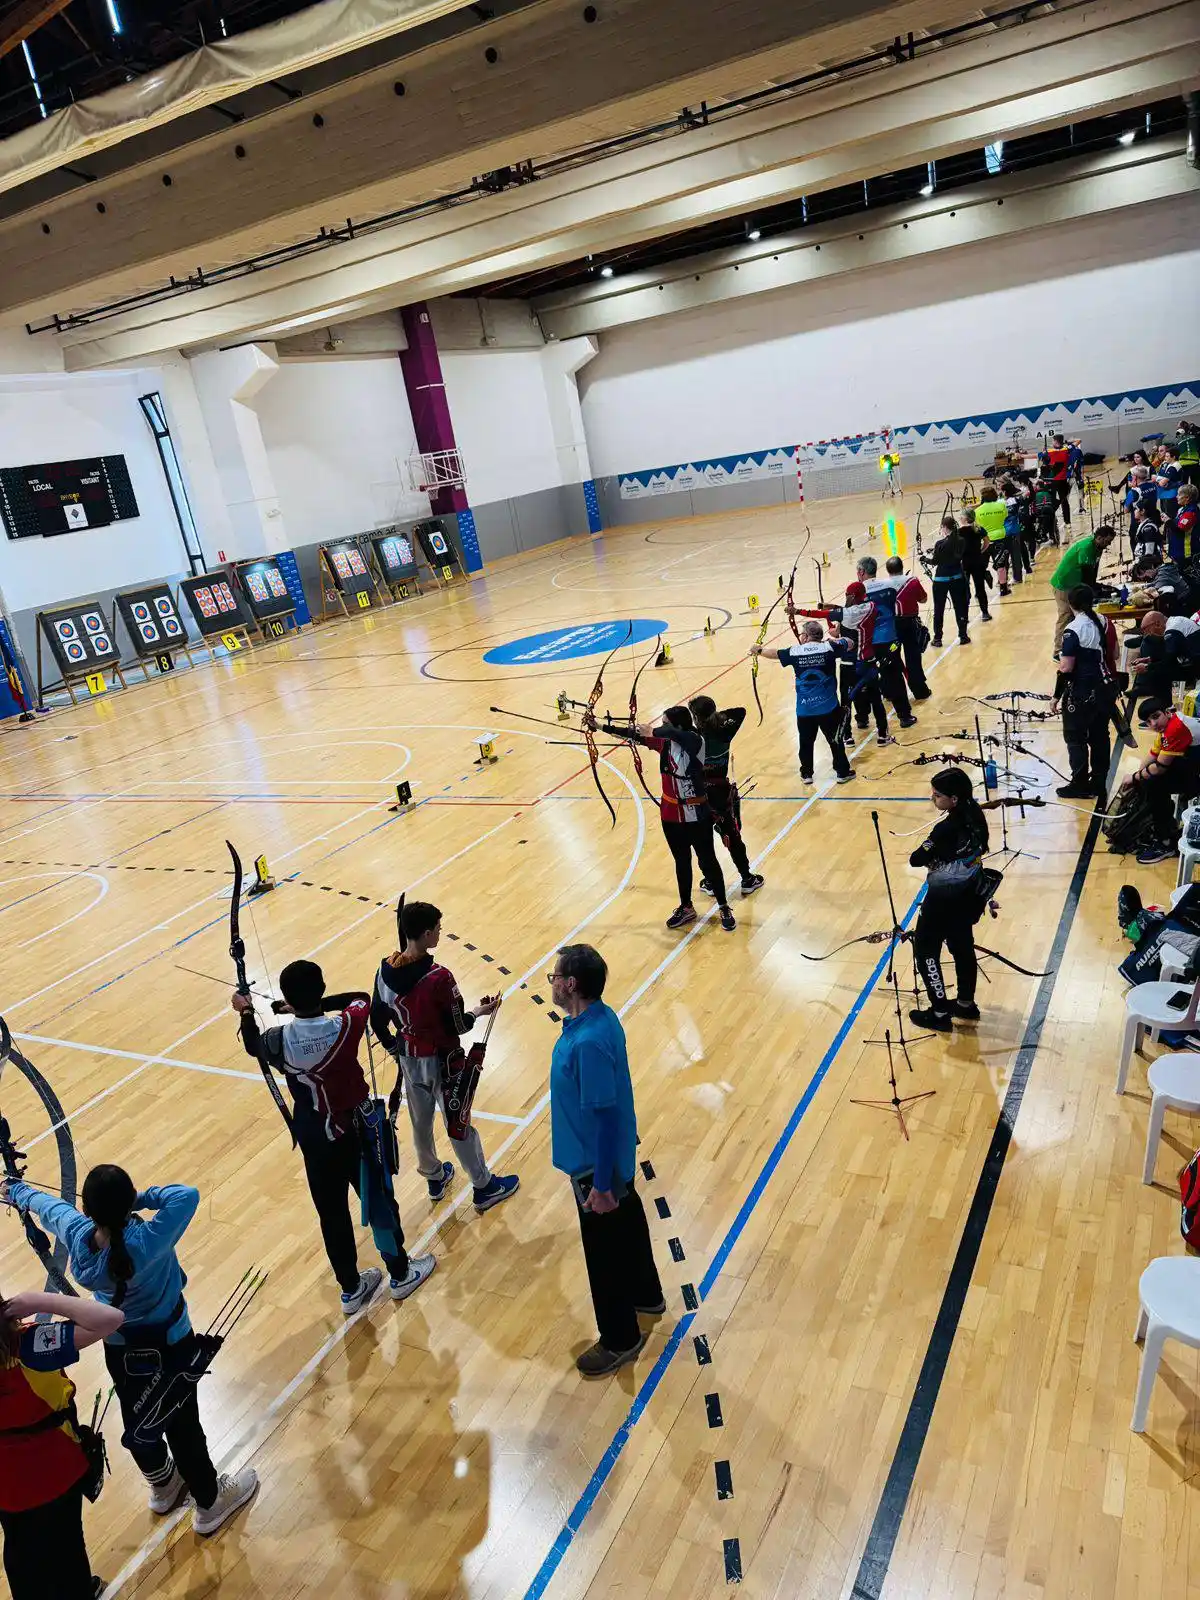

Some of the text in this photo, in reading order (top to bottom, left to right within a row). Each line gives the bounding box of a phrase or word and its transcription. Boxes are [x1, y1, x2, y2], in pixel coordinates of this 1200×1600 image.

[79, 476, 100, 485] VISITANT
[33, 483, 54, 492] LOCAL
[399, 585, 409, 597] 12
[359, 593, 368, 606] 11
[273, 622, 284, 636] 10
[227, 636, 236, 648] 9
[161, 656, 170, 671] 8
[91, 676, 100, 691] 7
[925, 958, 944, 1000] adidas
